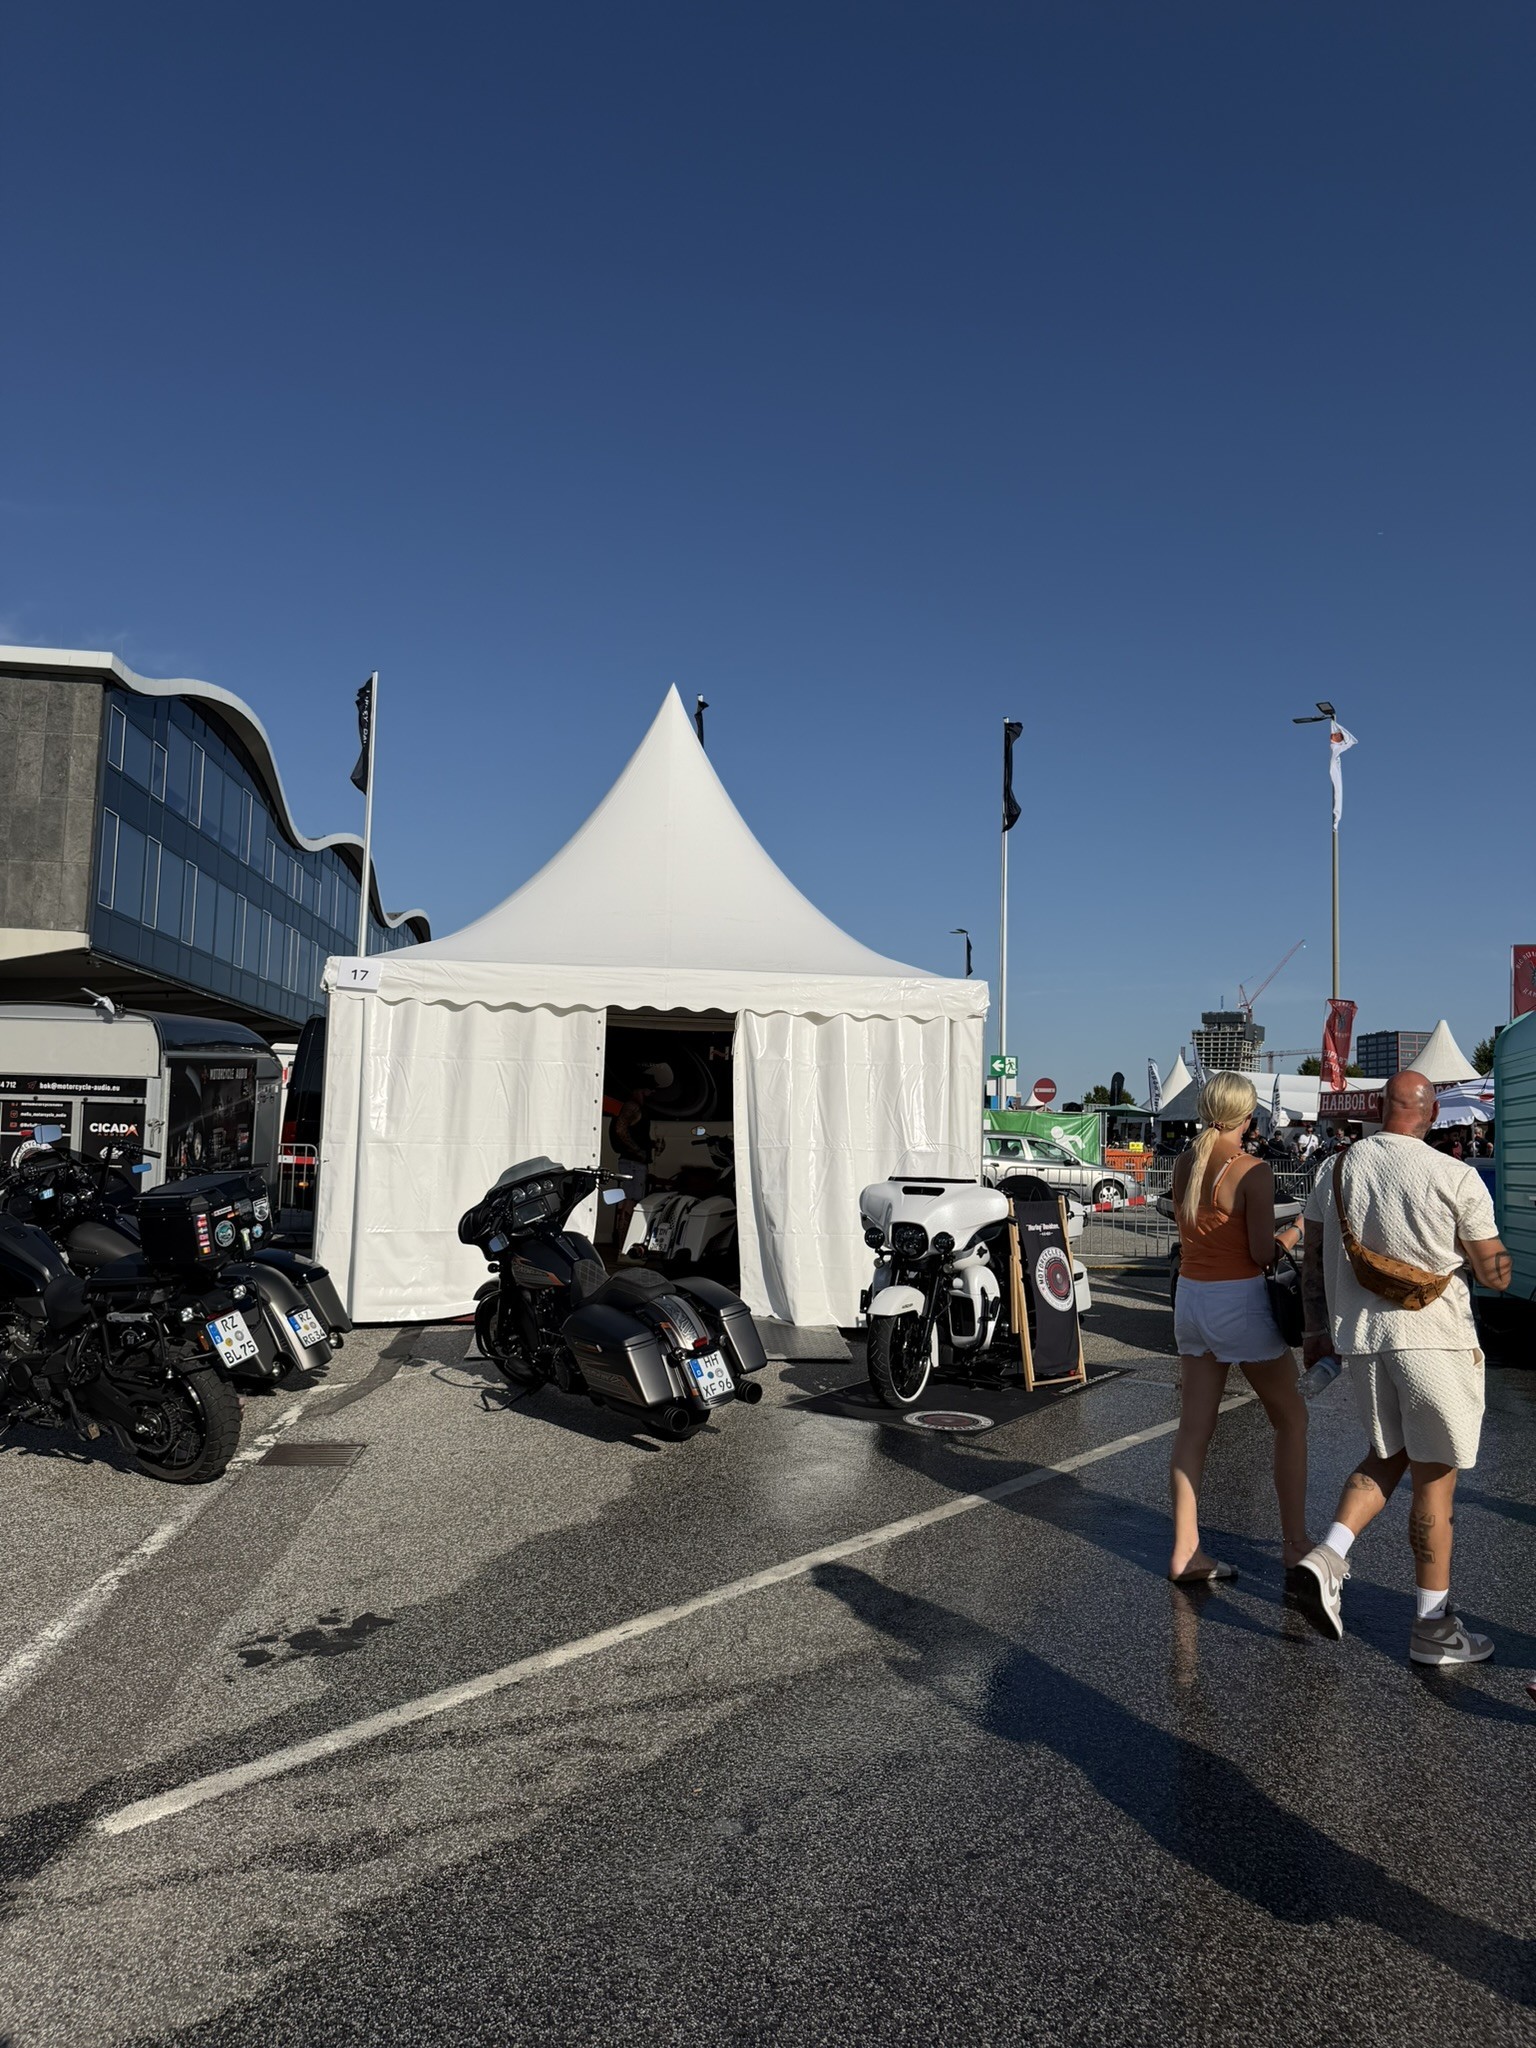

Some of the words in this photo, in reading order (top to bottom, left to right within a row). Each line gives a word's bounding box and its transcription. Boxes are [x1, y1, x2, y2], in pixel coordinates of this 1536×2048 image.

[351, 969, 369, 981] 17
[6, 1081, 17, 1089] 712
[1321, 1093, 1366, 1111] HARBOR
[89, 1122, 139, 1136] CICADA
[1037, 1248, 1063, 1285] MOTORCYCLES
[221, 1315, 239, 1332] RZ
[298, 1311, 312, 1323] RZ
[702, 1353, 719, 1368] HH
